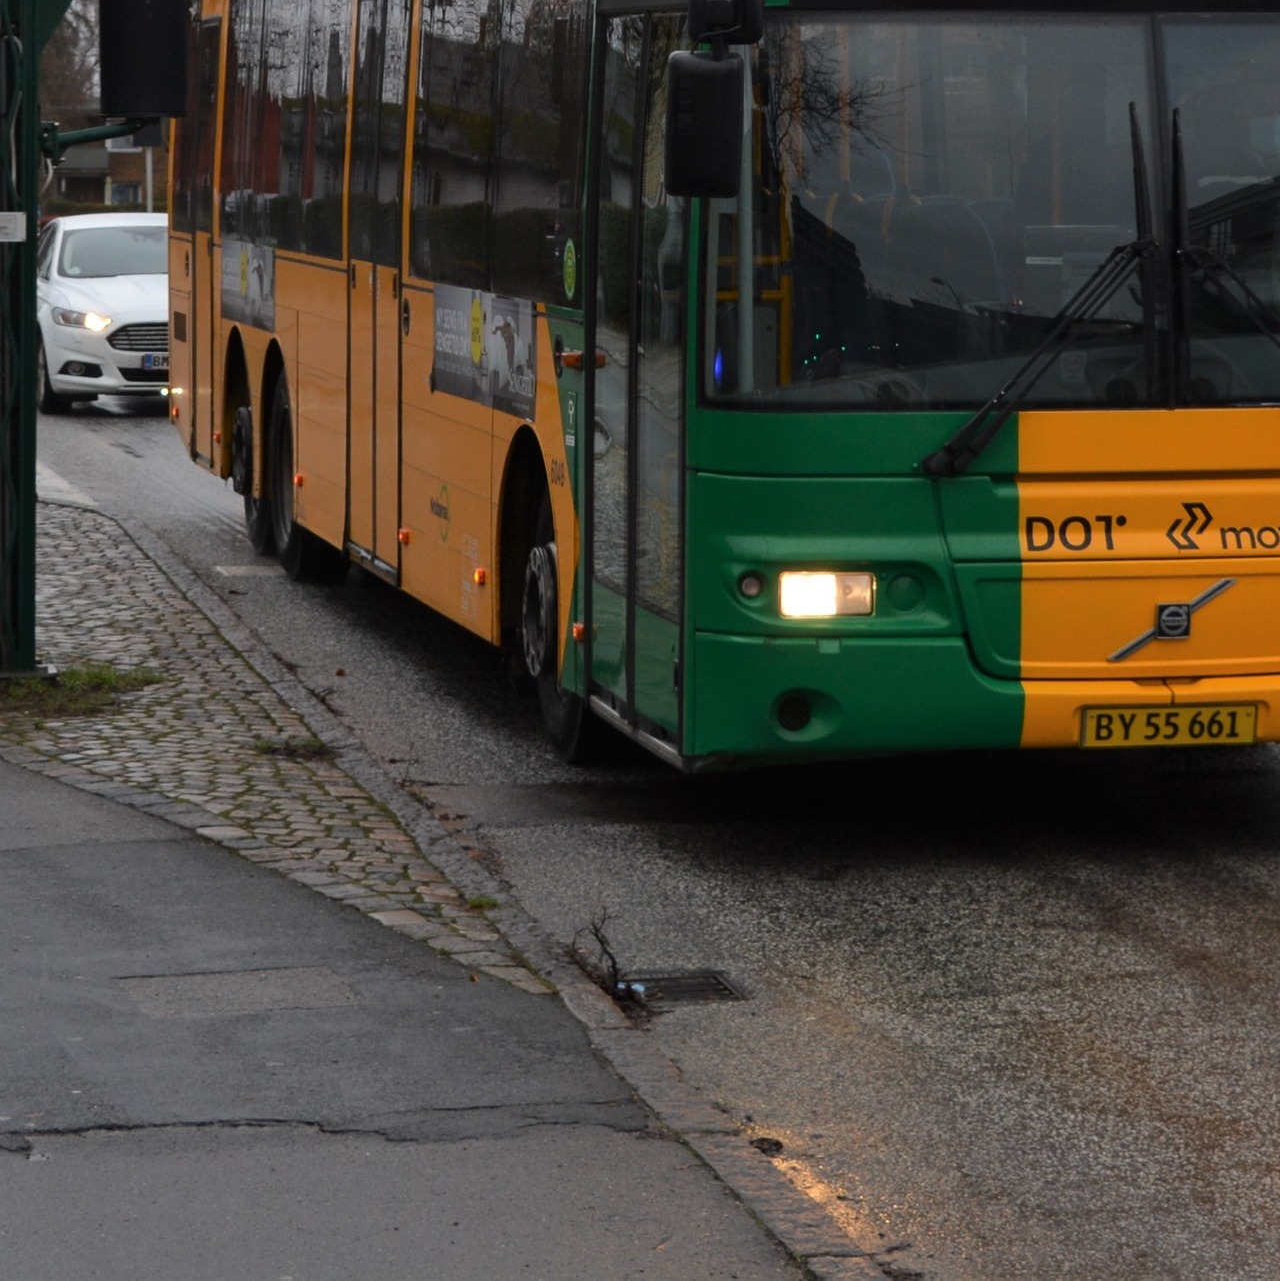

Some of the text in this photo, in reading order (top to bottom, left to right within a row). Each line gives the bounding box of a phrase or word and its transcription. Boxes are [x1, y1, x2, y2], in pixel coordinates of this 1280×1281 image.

[1095, 710, 1239, 741] BY 55 661
